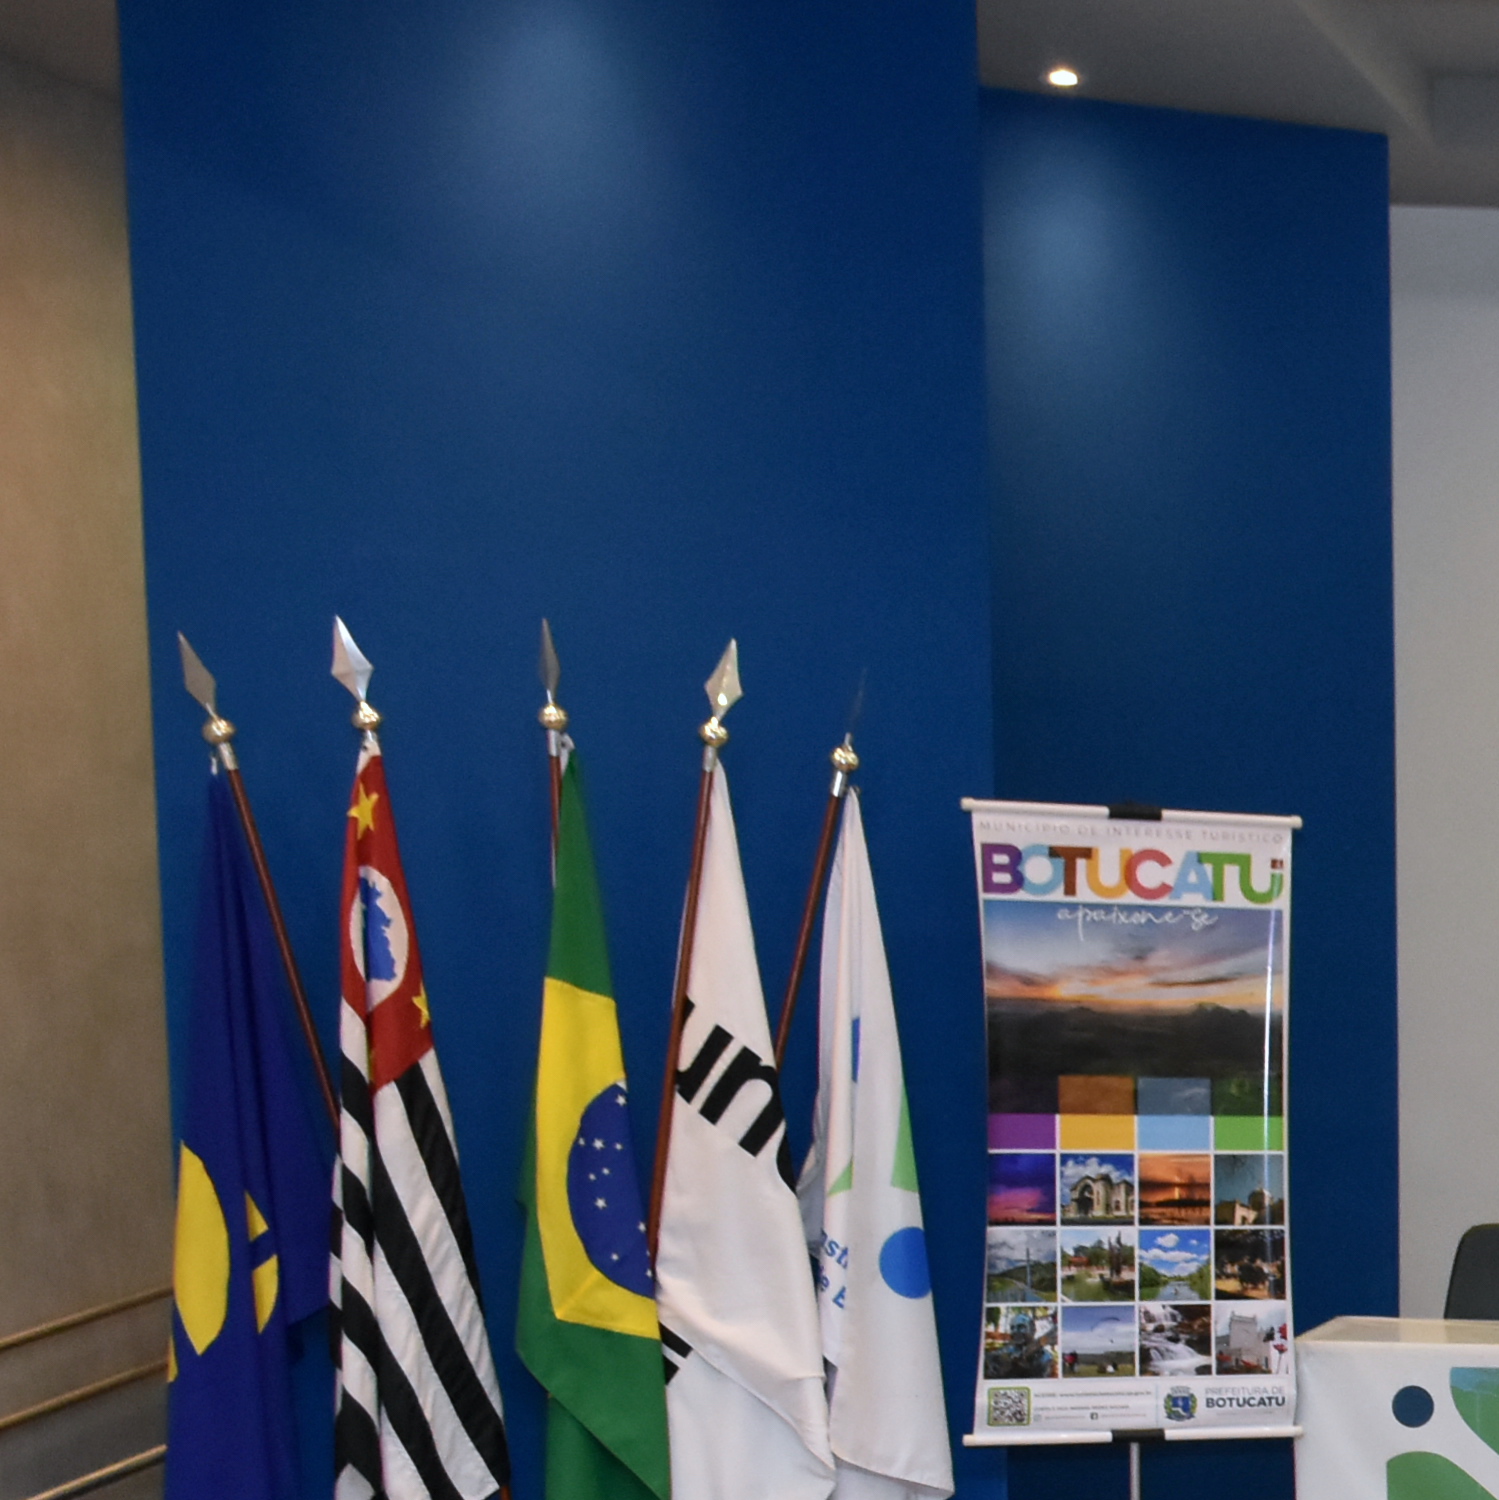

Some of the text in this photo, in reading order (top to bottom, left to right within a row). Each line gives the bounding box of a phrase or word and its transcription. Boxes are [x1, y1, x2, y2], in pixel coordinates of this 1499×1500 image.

[1106, 824, 1194, 841] INTERESSE
[980, 842, 1284, 905] BOTUCATU
[1056, 903, 1219, 942] apaixone-se
[1205, 1386, 1284, 1396] PREFEITURA DE
[1205, 1396, 1286, 1408] BOTUCATU
